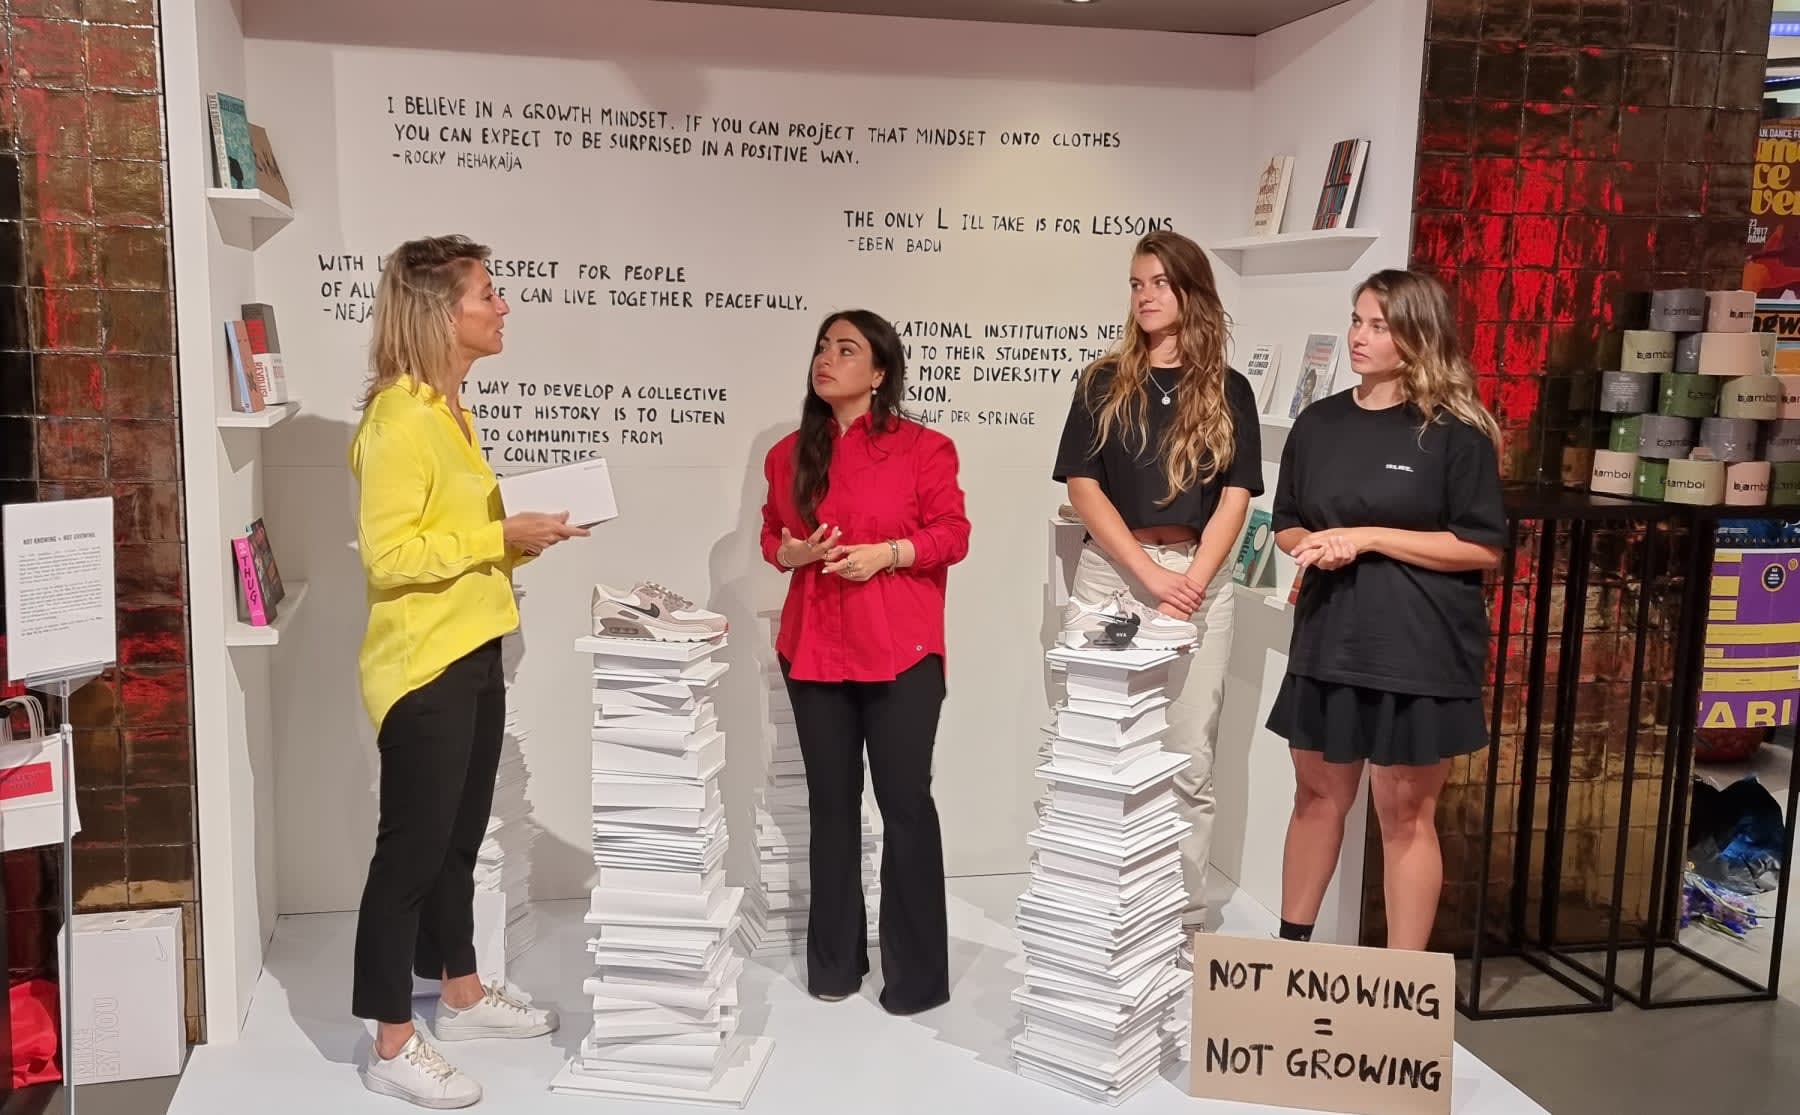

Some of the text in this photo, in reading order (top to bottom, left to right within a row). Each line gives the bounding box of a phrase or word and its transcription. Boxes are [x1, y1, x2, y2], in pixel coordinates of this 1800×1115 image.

[388, 96, 395, 114] I
[405, 96, 466, 116] BELIEVE
[475, 101, 493, 118] IN
[502, 104, 513, 118] A
[523, 103, 591, 124] GROWTH
[686, 114, 702, 133] IF
[712, 117, 742, 134] YOU
[749, 121, 779, 136] CAN
[868, 127, 908, 143] THAT
[916, 128, 986, 146] MINDSET
[1000, 131, 1040, 145] ONTO
[1053, 132, 1121, 148] CLOTHES
[1769, 128, 1792, 138] DANCE
[395, 123, 860, 165] YOU CAN EXPECT TO BE SURPRISED IN A POSITIVE WAY.
[843, 210, 875, 228] THE
[885, 212, 924, 229] ONLY
[938, 207, 949, 229] L
[992, 216, 1025, 233] TAKE
[1036, 218, 1047, 232] IS
[1055, 218, 1081, 235] FOR
[1092, 216, 1173, 235] LESSONS
[906, 238, 942, 253] BADU
[318, 254, 364, 273] WITH
[579, 264, 611, 281] FOR
[625, 265, 686, 282] PEOPLE
[321, 282, 342, 298] OF
[521, 288, 553, 303] CAN
[565, 289, 597, 305] LIVE
[609, 290, 693, 308] TOGETHER
[893, 321, 973, 339] CATIONAL
[985, 324, 1088, 340] INSTITUTIONS
[921, 345, 938, 360] TO
[945, 345, 986, 361] THEIR
[920, 365, 962, 383] MORE
[974, 366, 1061, 384] DIVERSITY
[477, 381, 509, 395] WAY
[517, 383, 537, 397] TO
[544, 384, 614, 400] DEVELOP
[621, 385, 633, 399] A
[638, 386, 728, 401] COLLECTIVE
[535, 405, 600, 421] HISTORY
[615, 407, 626, 421] IS
[637, 408, 657, 423] TO
[671, 409, 725, 425] LISTEN
[951, 410, 971, 424] DER
[978, 411, 1036, 426] SPRINGE
[481, 428, 664, 445] TO COMMUNITIES FROM
[239, 555, 257, 606] THUG
[1699, 698, 1791, 728] ARI
[1209, 958, 1440, 1020] NOT KNOWING
[1206, 1036, 1442, 1093] NOT GROWING
